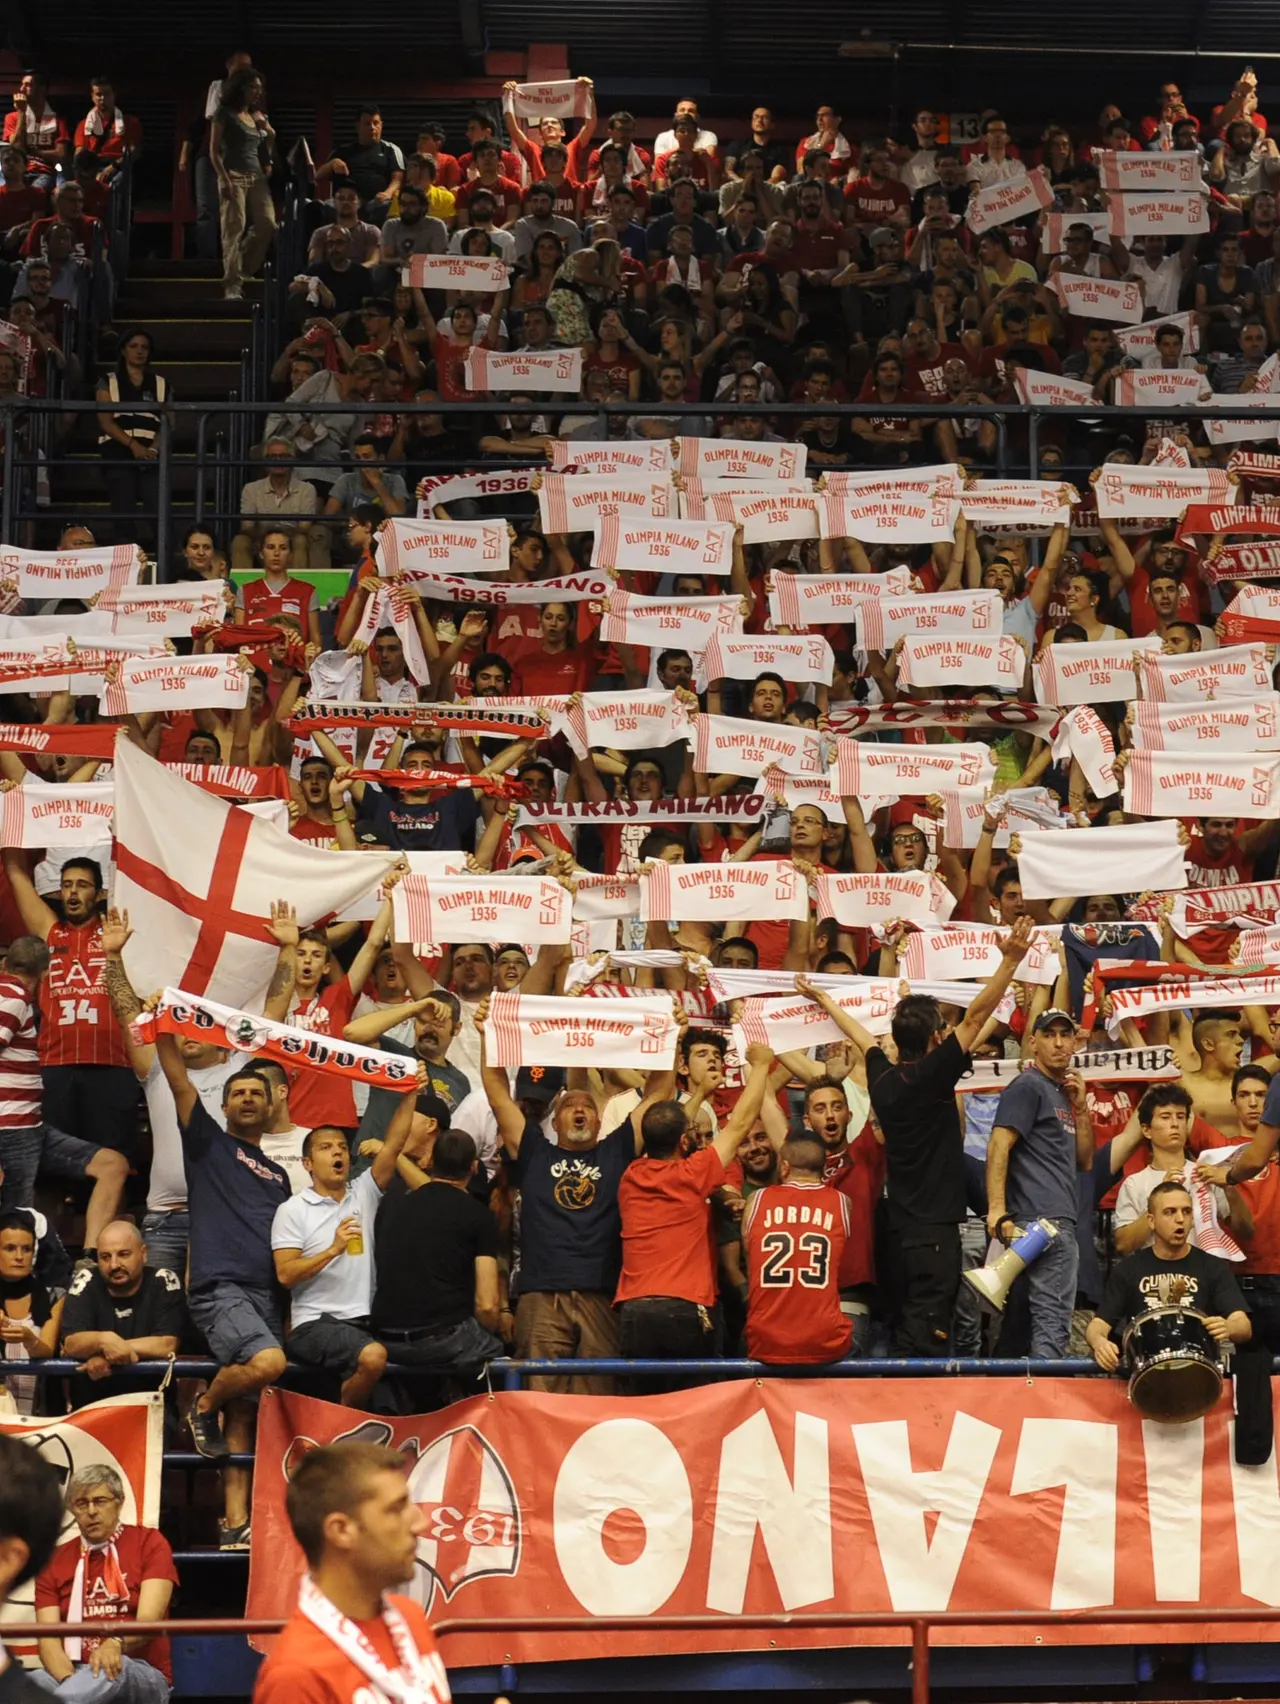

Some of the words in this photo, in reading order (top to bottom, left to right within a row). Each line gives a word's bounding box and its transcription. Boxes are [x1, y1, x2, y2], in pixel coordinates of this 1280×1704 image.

[957, 119, 979, 139] 13
[573, 452, 609, 465] OLIMPIA
[475, 478, 529, 493] 1936
[610, 490, 645, 506] MILANO
[741, 499, 777, 517] OLIMPIA
[1210, 505, 1256, 530] OLIMPIA
[404, 536, 440, 551] OLIMPIA
[442, 535, 477, 549] MILANO
[625, 529, 661, 545] OLIMPIA
[663, 533, 699, 551] MILANO
[447, 587, 508, 604] 1936
[804, 583, 843, 598] OLIMPIA
[845, 583, 879, 595] MILANO
[831, 595, 852, 605] 1936
[124, 602, 157, 615] OLIMPIA
[633, 606, 671, 618] OLIMPIA
[673, 606, 712, 622] MILANO
[929, 606, 965, 617] MILANO
[147, 611, 167, 623] 1936
[659, 616, 681, 629] 1936
[916, 615, 938, 628] 1936
[914, 643, 953, 660] OLIMPIA
[956, 642, 992, 659] MILANO
[940, 655, 962, 668] 1936
[1062, 661, 1100, 677] OLIMPIA
[1103, 658, 1134, 669] MILAN
[179, 665, 218, 680] MILANO
[1088, 673, 1111, 685] 1936
[1169, 667, 1209, 685] OLIMPIA
[161, 677, 186, 690] 1936
[1197, 677, 1220, 690] 1936
[587, 705, 626, 723] OLIMPIA
[1168, 716, 1209, 732] OLIMPIA
[715, 735, 755, 749] OLIMPIA
[741, 748, 764, 762] 1936
[207, 765, 258, 795] MILANO
[1207, 774, 1246, 791] MILANO
[1188, 787, 1213, 800] 1936
[649, 795, 765, 816] MILANO
[677, 872, 723, 889] OLIMPIA
[726, 870, 768, 887] MILANO
[708, 884, 735, 899] 1936
[438, 891, 484, 911] OLIMPIA
[471, 906, 497, 921] 1936
[58, 999, 100, 1026] 34
[565, 1032, 594, 1047] 1936
[763, 1208, 833, 1231] JORDAN
[761, 1231, 832, 1290] 23
